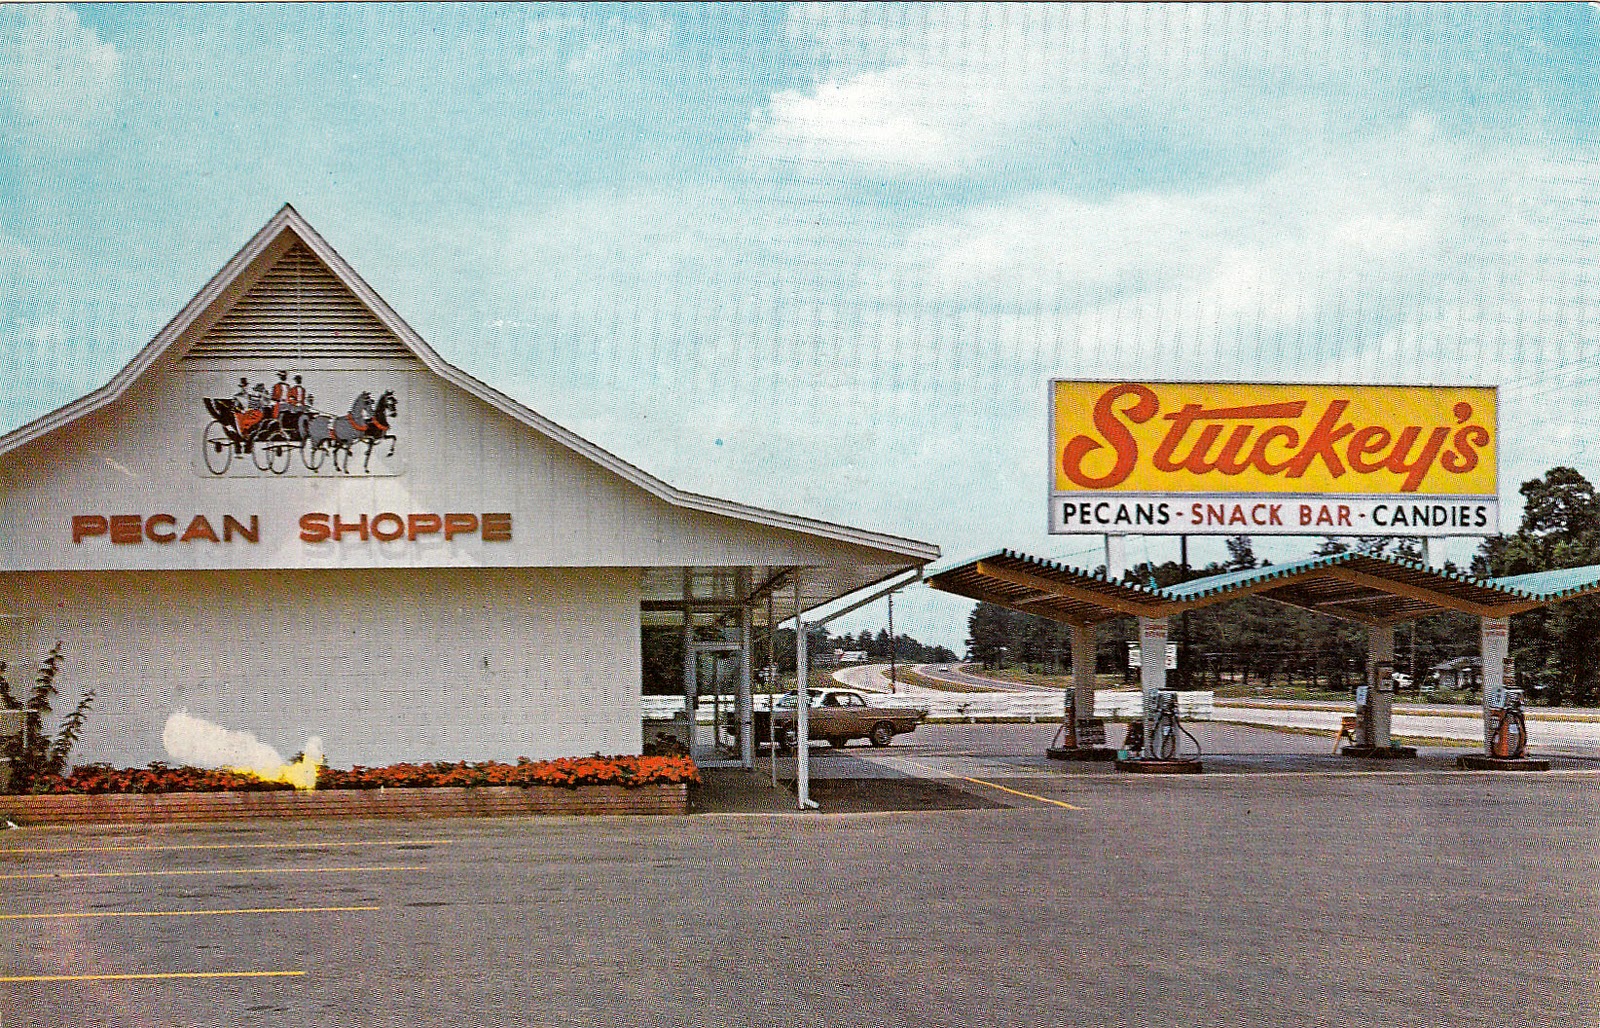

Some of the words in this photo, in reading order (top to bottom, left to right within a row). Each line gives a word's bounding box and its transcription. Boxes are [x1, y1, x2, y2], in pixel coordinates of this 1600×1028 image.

[1062, 384, 1490, 493] Stuckey's
[72, 514, 260, 544] PECAN
[299, 512, 512, 543] SHOPPE
[1191, 504, 1282, 526] SNACK
[1372, 504, 1488, 528] CANDIES
